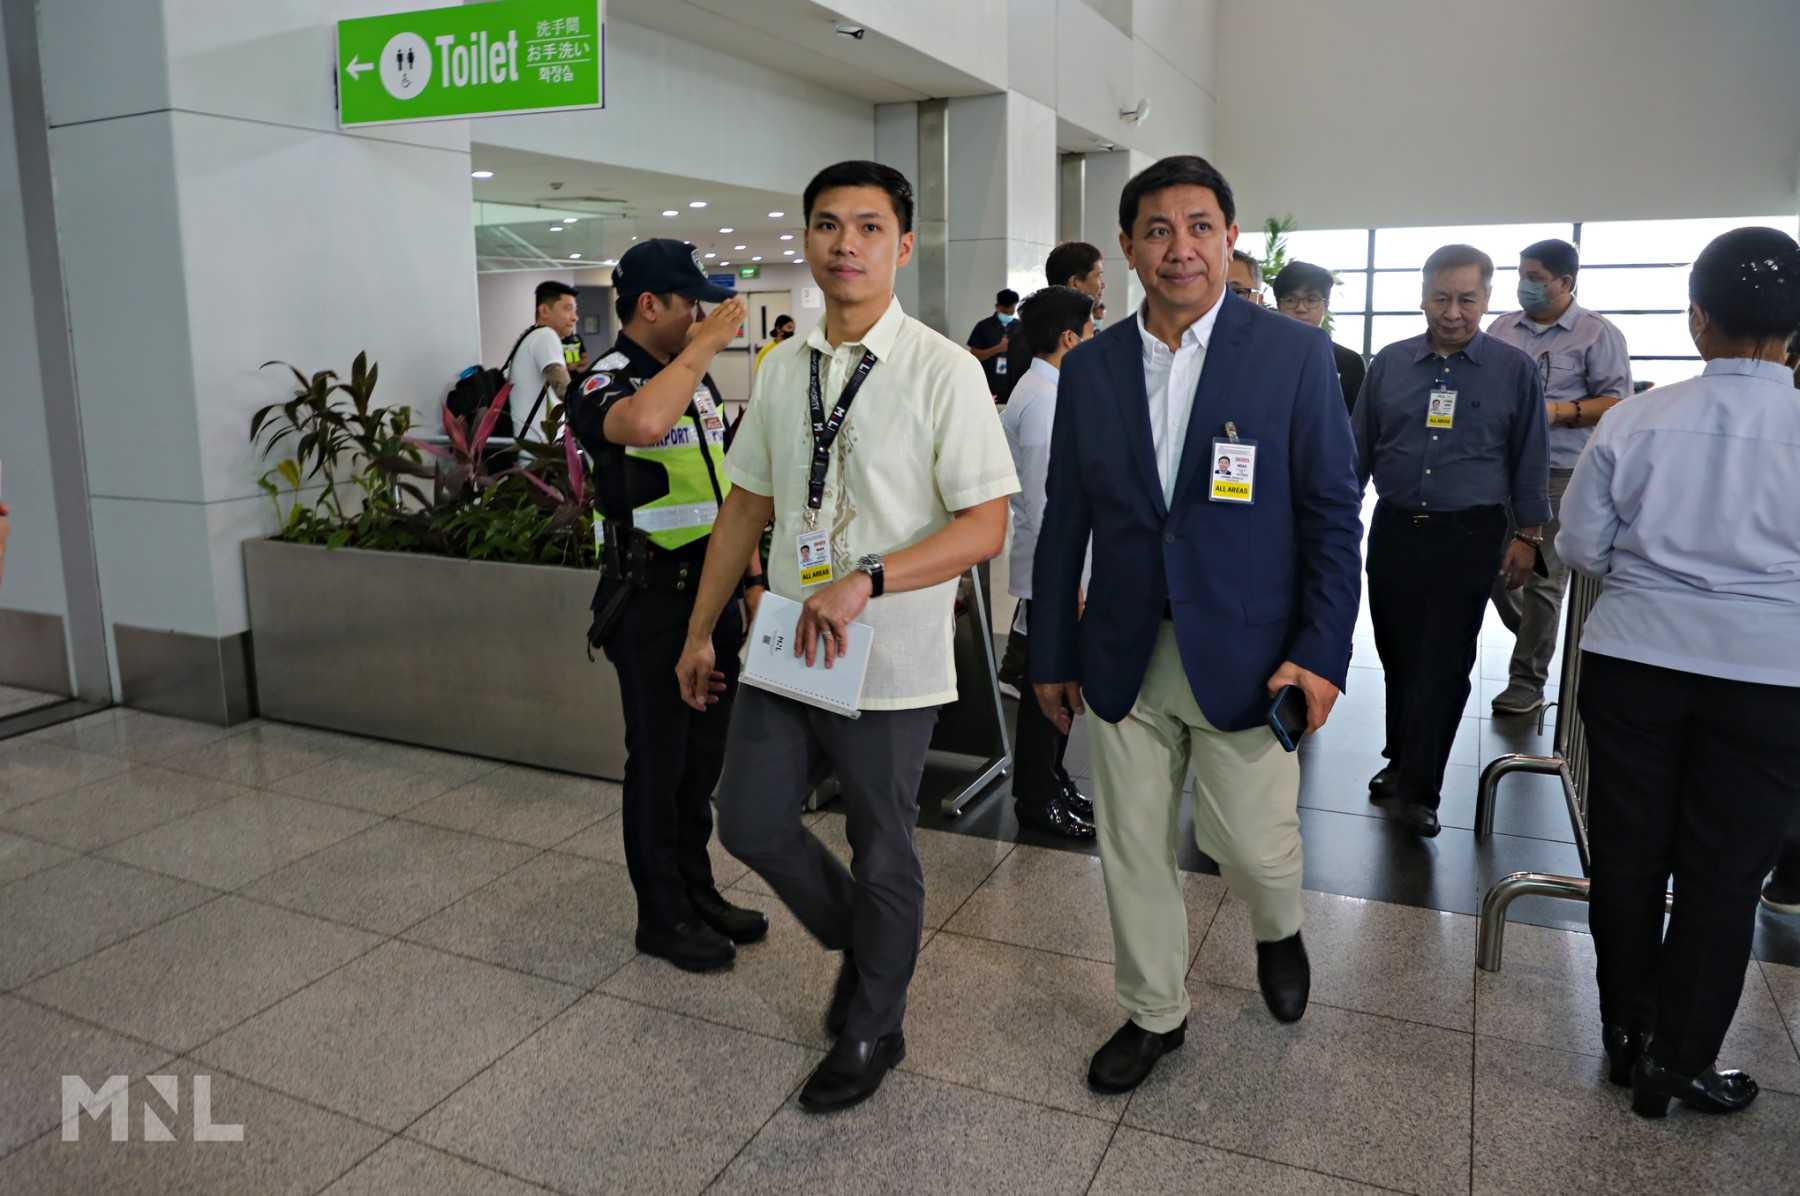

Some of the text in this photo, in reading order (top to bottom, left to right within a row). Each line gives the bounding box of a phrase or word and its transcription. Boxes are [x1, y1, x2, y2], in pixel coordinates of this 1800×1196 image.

[435, 30, 519, 88] Toilet
[527, 42, 591, 61] お手洗い
[1215, 484, 1248, 495] ALL AREAS
